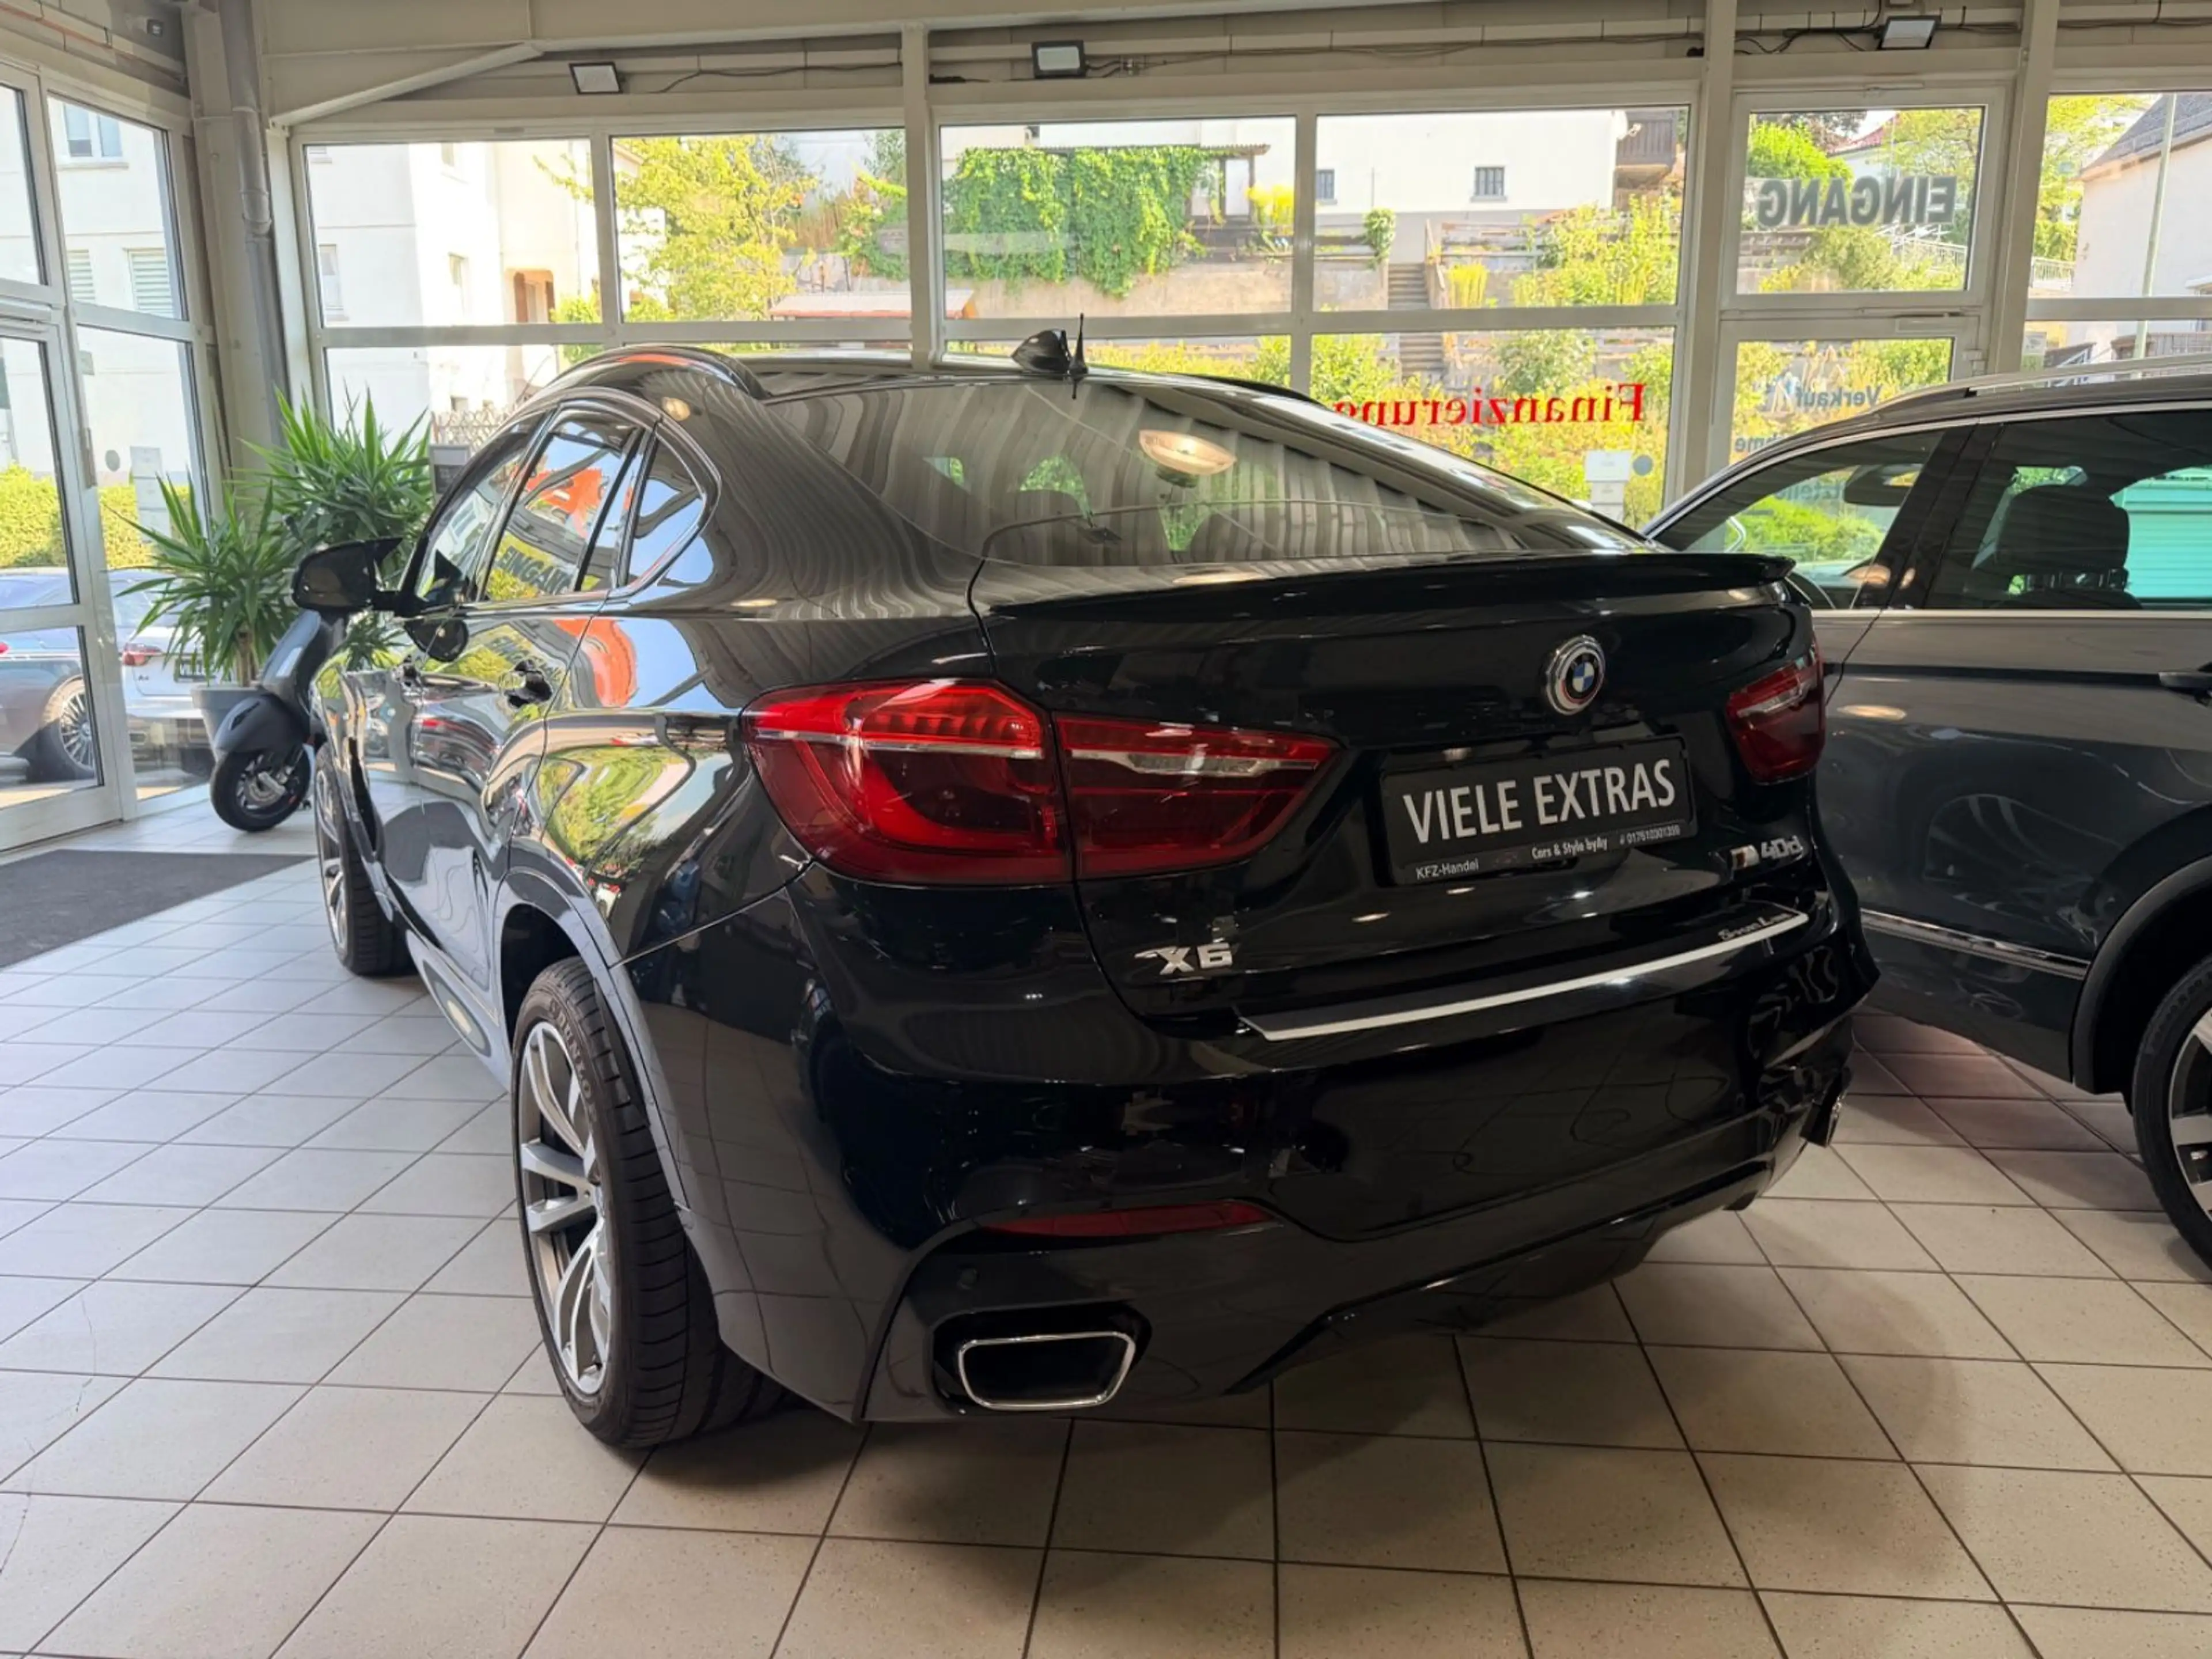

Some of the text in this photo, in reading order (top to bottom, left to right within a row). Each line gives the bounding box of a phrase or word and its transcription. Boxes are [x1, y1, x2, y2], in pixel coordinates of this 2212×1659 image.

[1403, 758, 1676, 844] VIELE EXTRAS
[1416, 858, 1479, 880] KFZ-Handel
[1531, 847, 1552, 860] Cars
[1554, 843, 1562, 857] &
[1562, 839, 1584, 857] Style
[1760, 835, 1804, 859] 40d
[1134, 942, 1233, 975] X6
